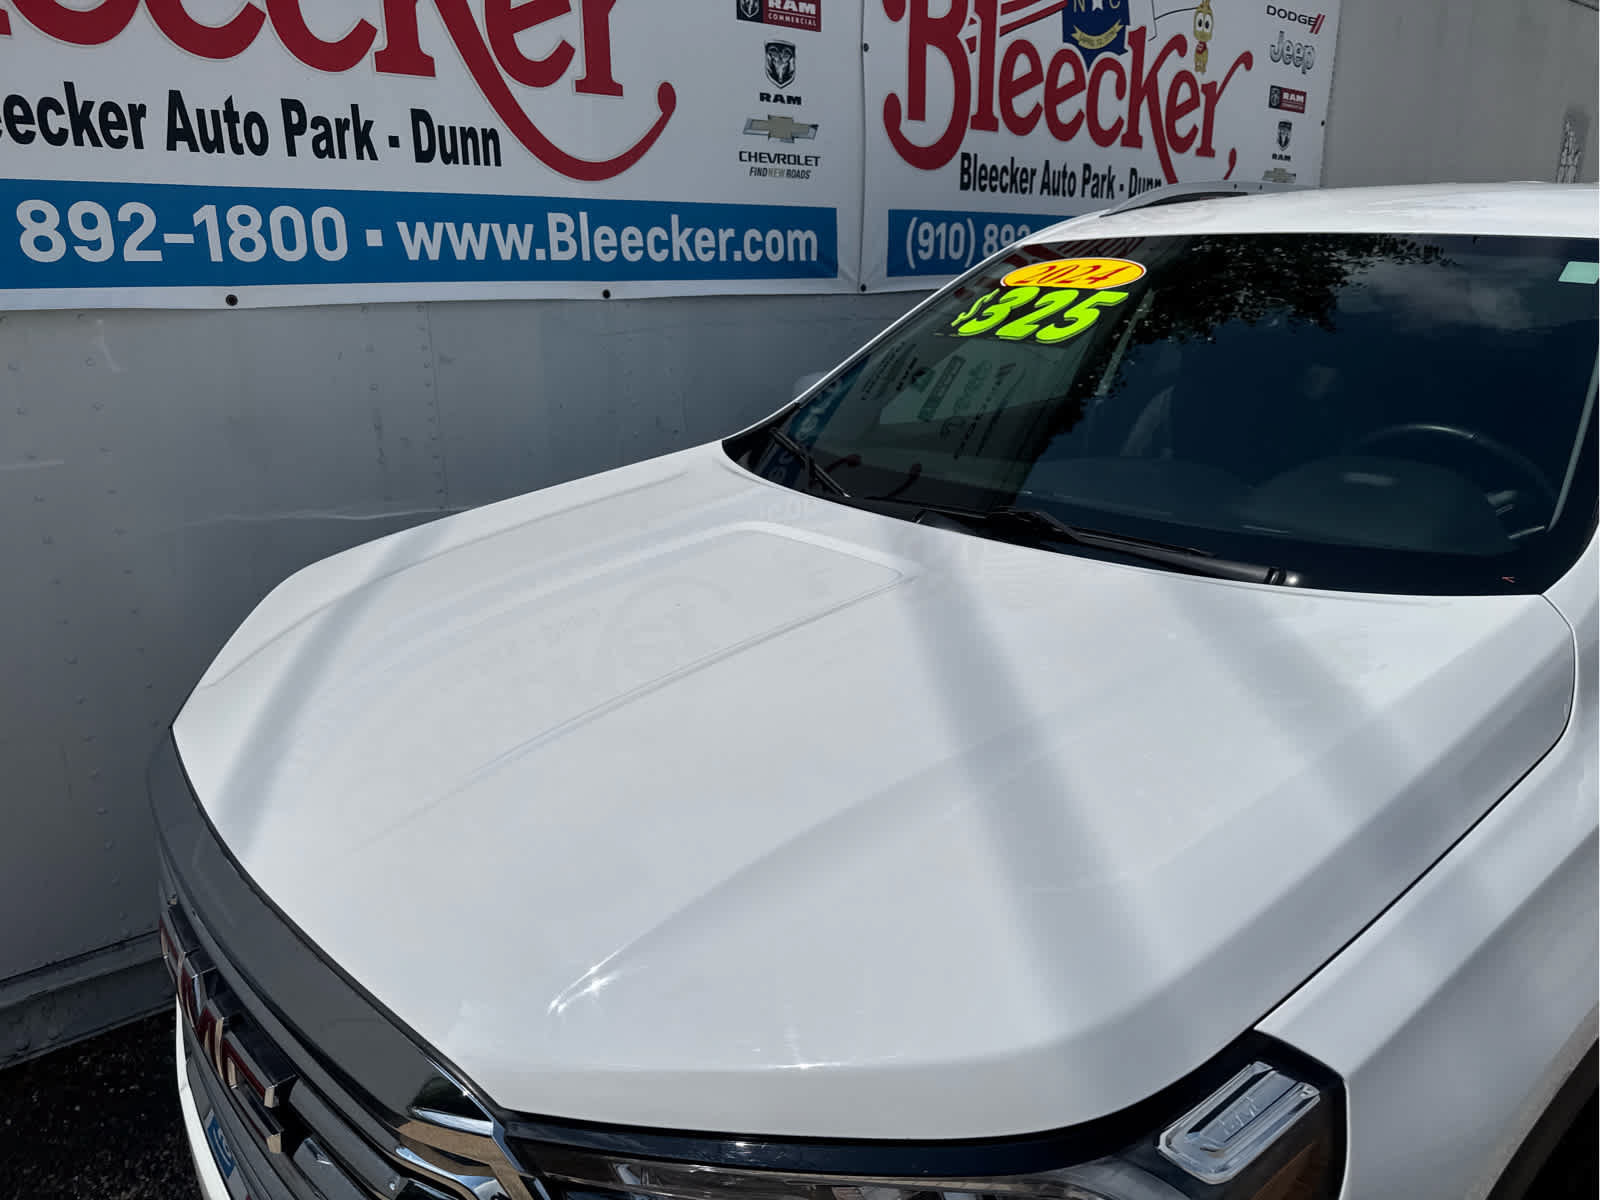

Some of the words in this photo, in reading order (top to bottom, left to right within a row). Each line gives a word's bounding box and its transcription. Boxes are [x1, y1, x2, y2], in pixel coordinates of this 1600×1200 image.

[768, 0, 816, 15] RAM
[1266, 4, 1317, 26] DODGE
[768, 12, 817, 27] COMMERCIAL
[1270, 30, 1316, 75] Jeep
[759, 92, 802, 105] RAM
[1282, 91, 1305, 103] RAM
[0, 81, 147, 150] ecker
[166, 89, 270, 157] Auto
[280, 98, 380, 161] Park
[410, 107, 502, 167] Dunn
[739, 150, 821, 167] CHEVROLET
[1272, 153, 1291, 161] RAM
[959, 152, 1037, 195] Bleecker
[1040, 160, 1077, 198] Auto
[1081, 163, 1116, 200] Park
[16, 199, 350, 264] 892-1800
[396, 210, 818, 264] www.Bleecker.com
[906, 216, 976, 270] (910)
[1015, 264, 1132, 286] 2024
[951, 286, 1130, 344] $325
